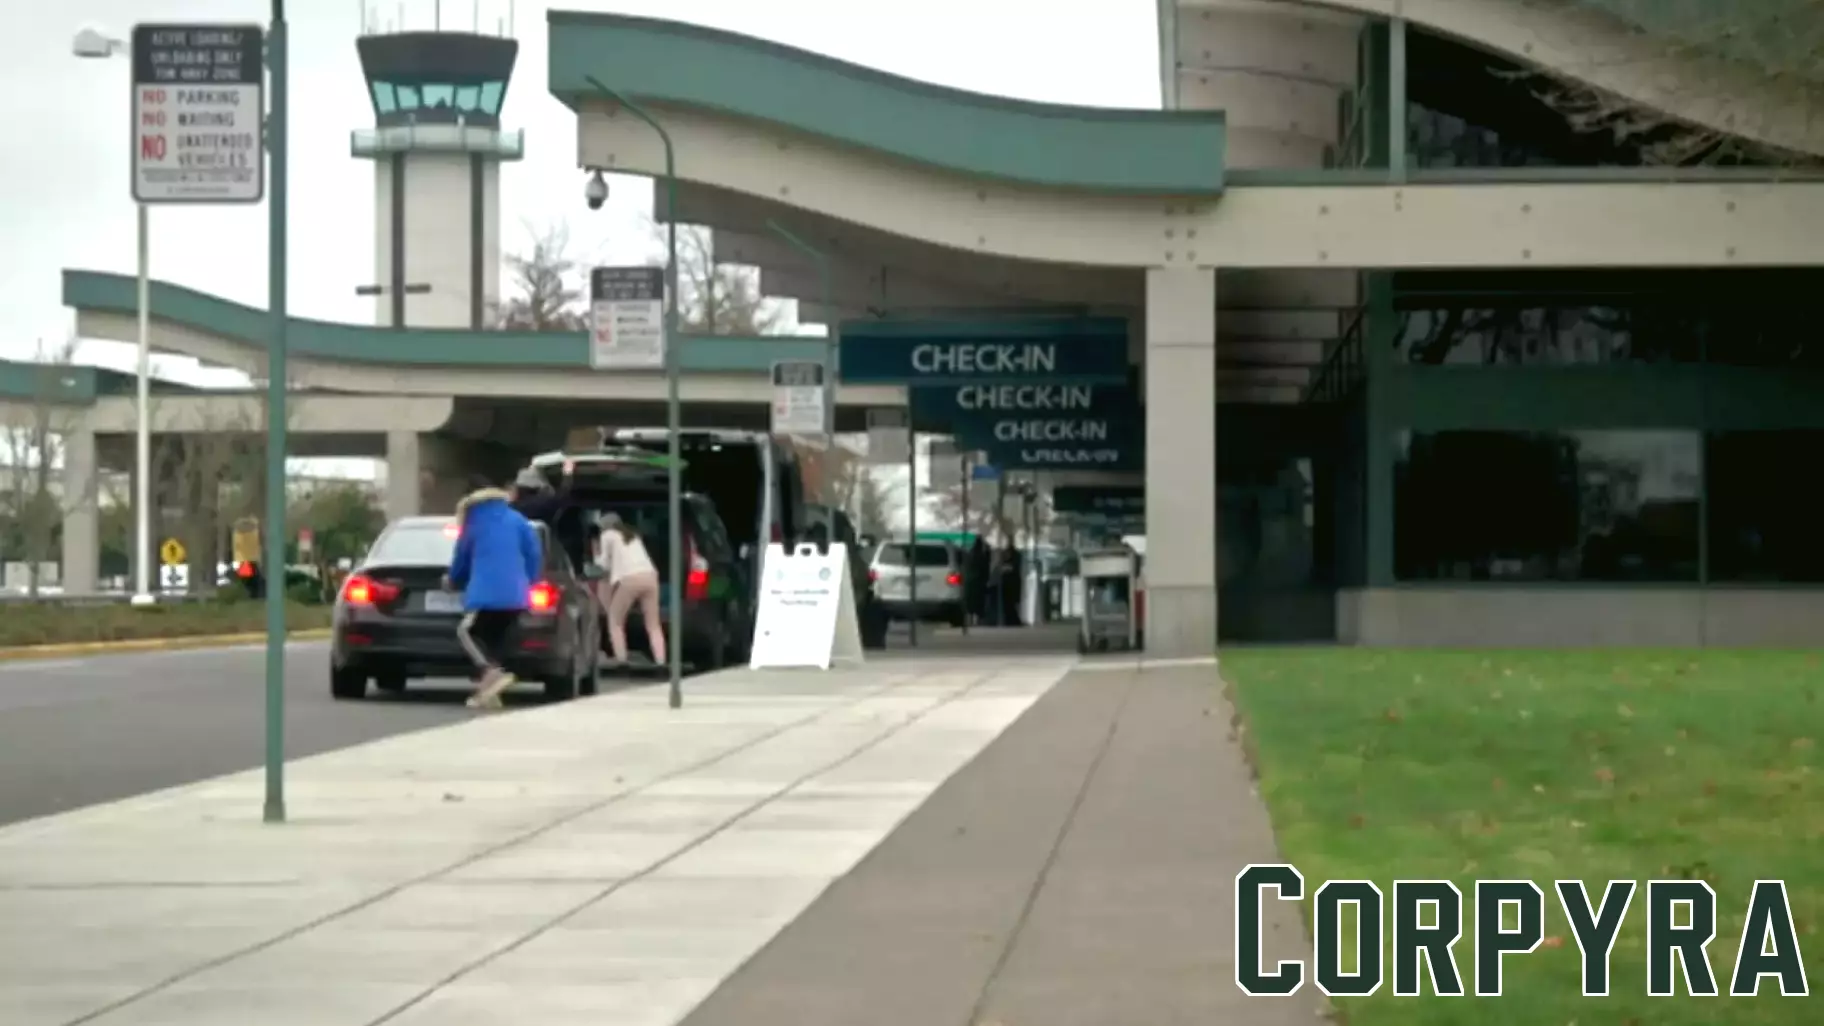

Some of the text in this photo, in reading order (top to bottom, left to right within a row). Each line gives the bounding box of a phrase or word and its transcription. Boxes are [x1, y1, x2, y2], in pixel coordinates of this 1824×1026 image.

[142, 89, 240, 106] NO PARKING
[142, 111, 235, 127] NO WAITING
[141, 133, 253, 161] NO UNATTENDED
[911, 344, 1056, 373] CHECK-IN
[956, 386, 1092, 409] CHECK-IN
[994, 421, 1107, 442] CHECK-IN
